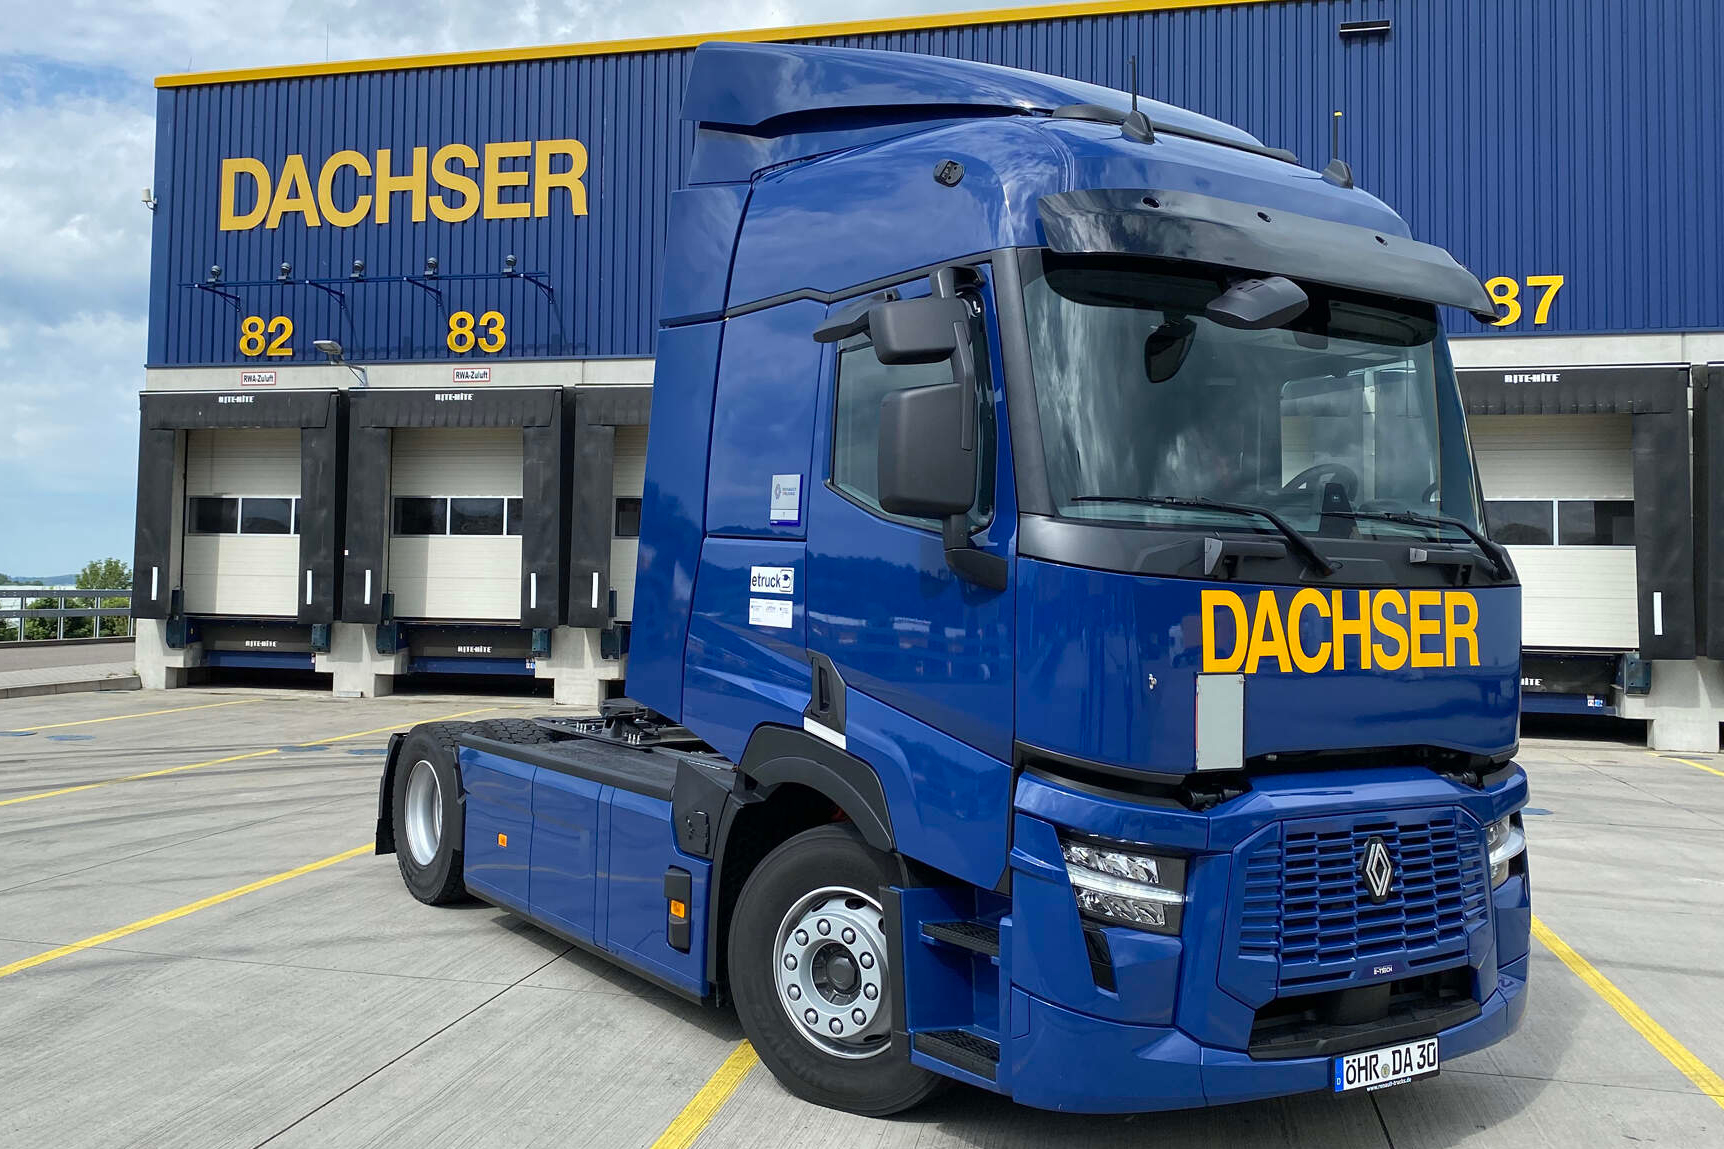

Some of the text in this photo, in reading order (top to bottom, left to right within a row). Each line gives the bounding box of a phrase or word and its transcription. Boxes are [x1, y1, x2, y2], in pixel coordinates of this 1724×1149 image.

[219, 138, 589, 231] DACHSER
[239, 316, 294, 356] 82
[447, 311, 507, 353] 83
[455, 370, 488, 379] RWA-Zuluft
[1504, 372, 1560, 383] RITE-HITE
[751, 573, 781, 588] etruck
[1201, 588, 1480, 674] DACHSER
[1345, 1053, 1380, 1085] ÖHR
[1391, 1047, 1413, 1076] DA
[1416, 1042, 1437, 1070] 30
